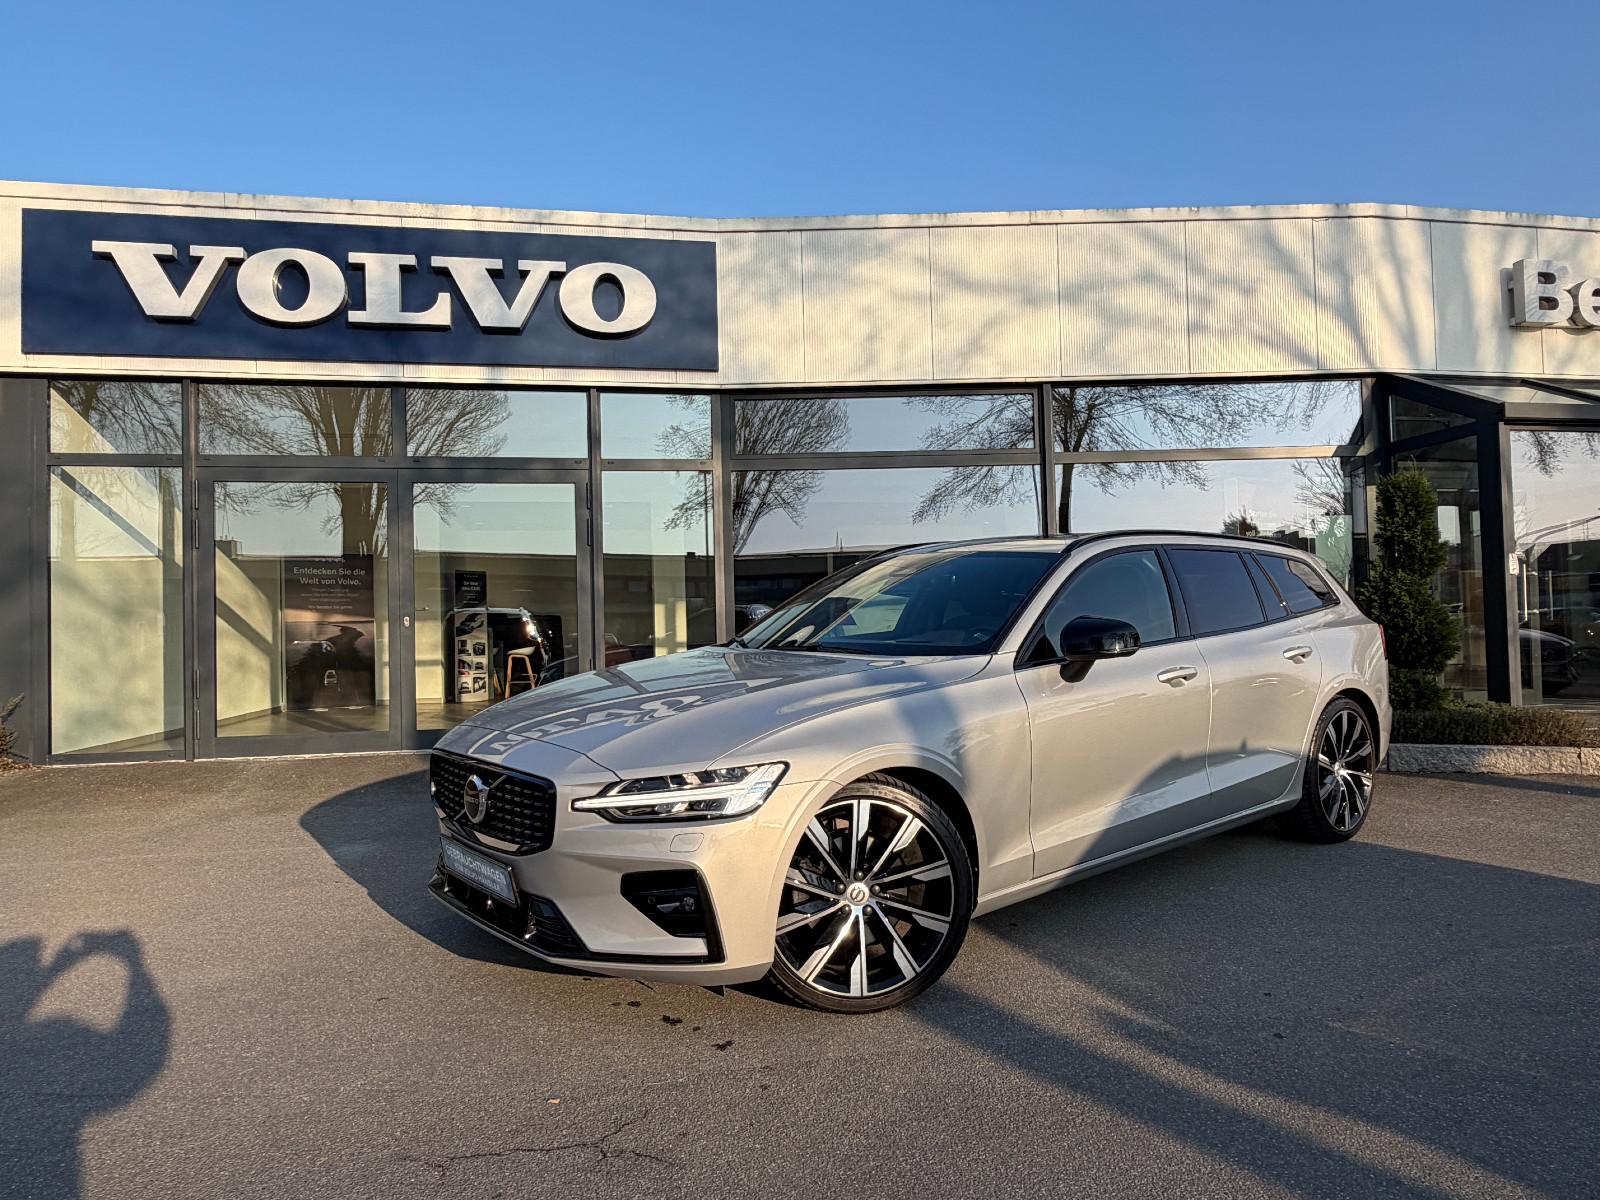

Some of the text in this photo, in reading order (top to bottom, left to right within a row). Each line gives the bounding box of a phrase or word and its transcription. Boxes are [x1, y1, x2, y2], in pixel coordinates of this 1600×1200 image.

[91, 240, 658, 337] VOLVO
[293, 566, 366, 576] Entdecken Sie die
[299, 576, 320, 585] Welt
[337, 577, 361, 586] Volvo.
